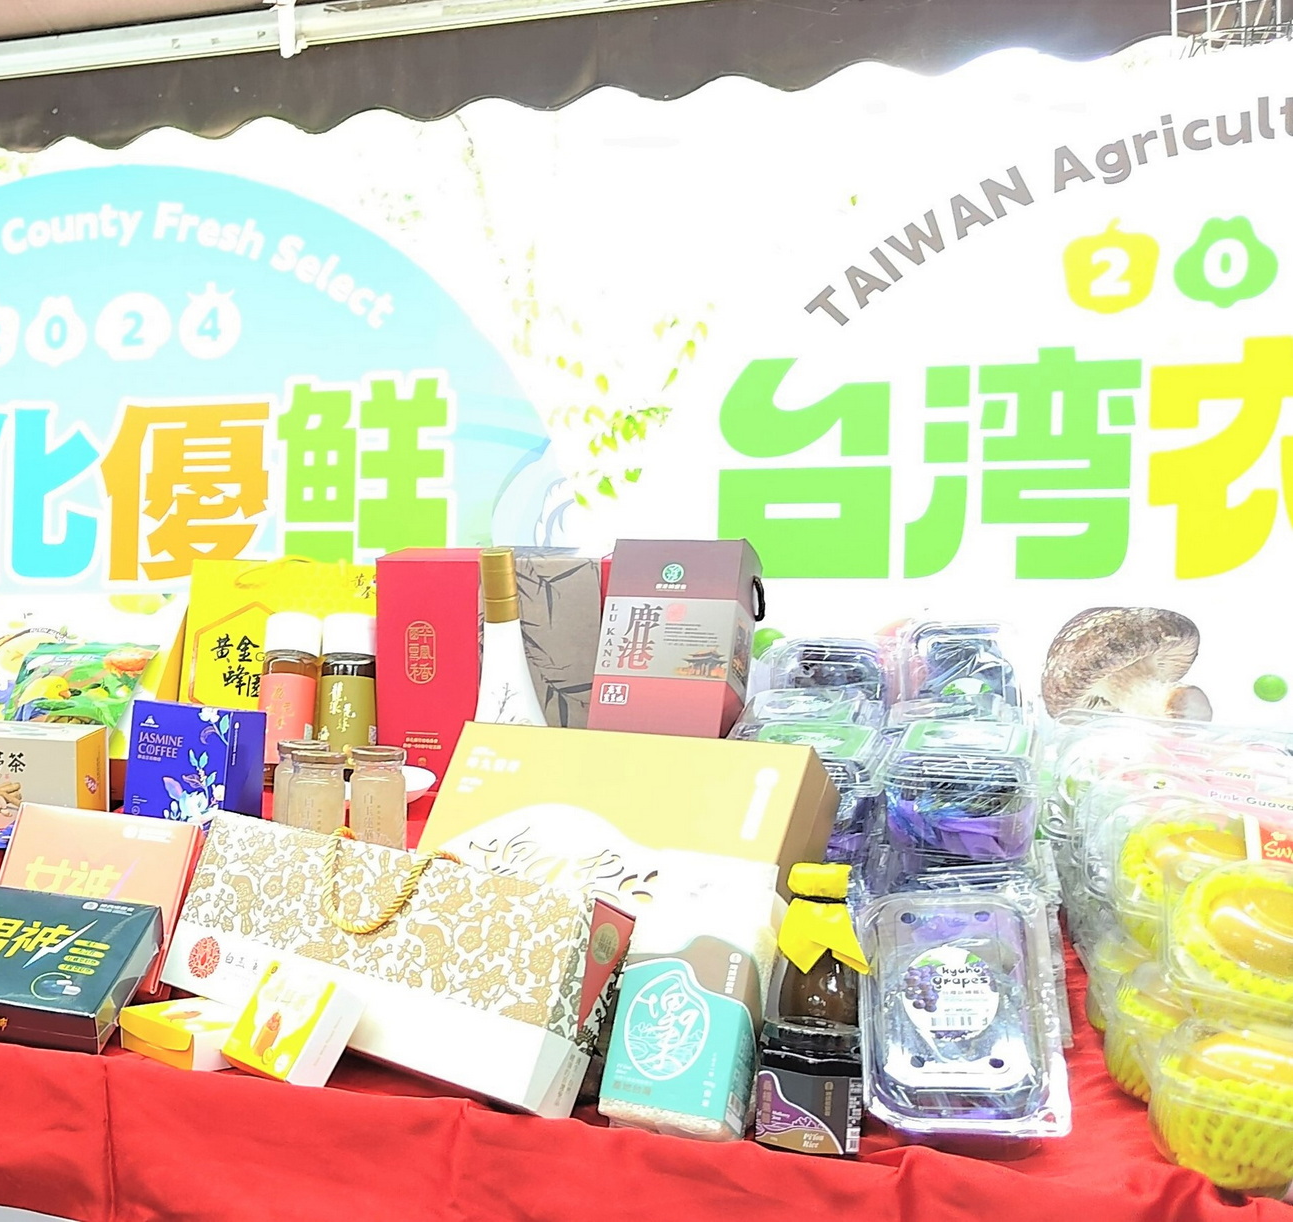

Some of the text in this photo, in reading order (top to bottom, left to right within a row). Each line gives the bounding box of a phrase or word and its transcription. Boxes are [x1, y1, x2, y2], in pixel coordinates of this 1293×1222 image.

[804, 166, 1034, 327] TAIWAN
[1, 204, 142, 256] County
[152, 201, 265, 261] Fresh
[270, 234, 395, 330] Select
[601, 603, 618, 668] LUKANG
[617, 603, 663, 670] 鹿港
[210, 633, 260, 663] 黃金
[138, 743, 178, 759] COFFEE
[139, 732, 184, 748] JASMINE
[1210, 790, 1239, 802] Pink
[932, 976, 989, 990] grapes
[942, 966, 981, 977] kyoho
